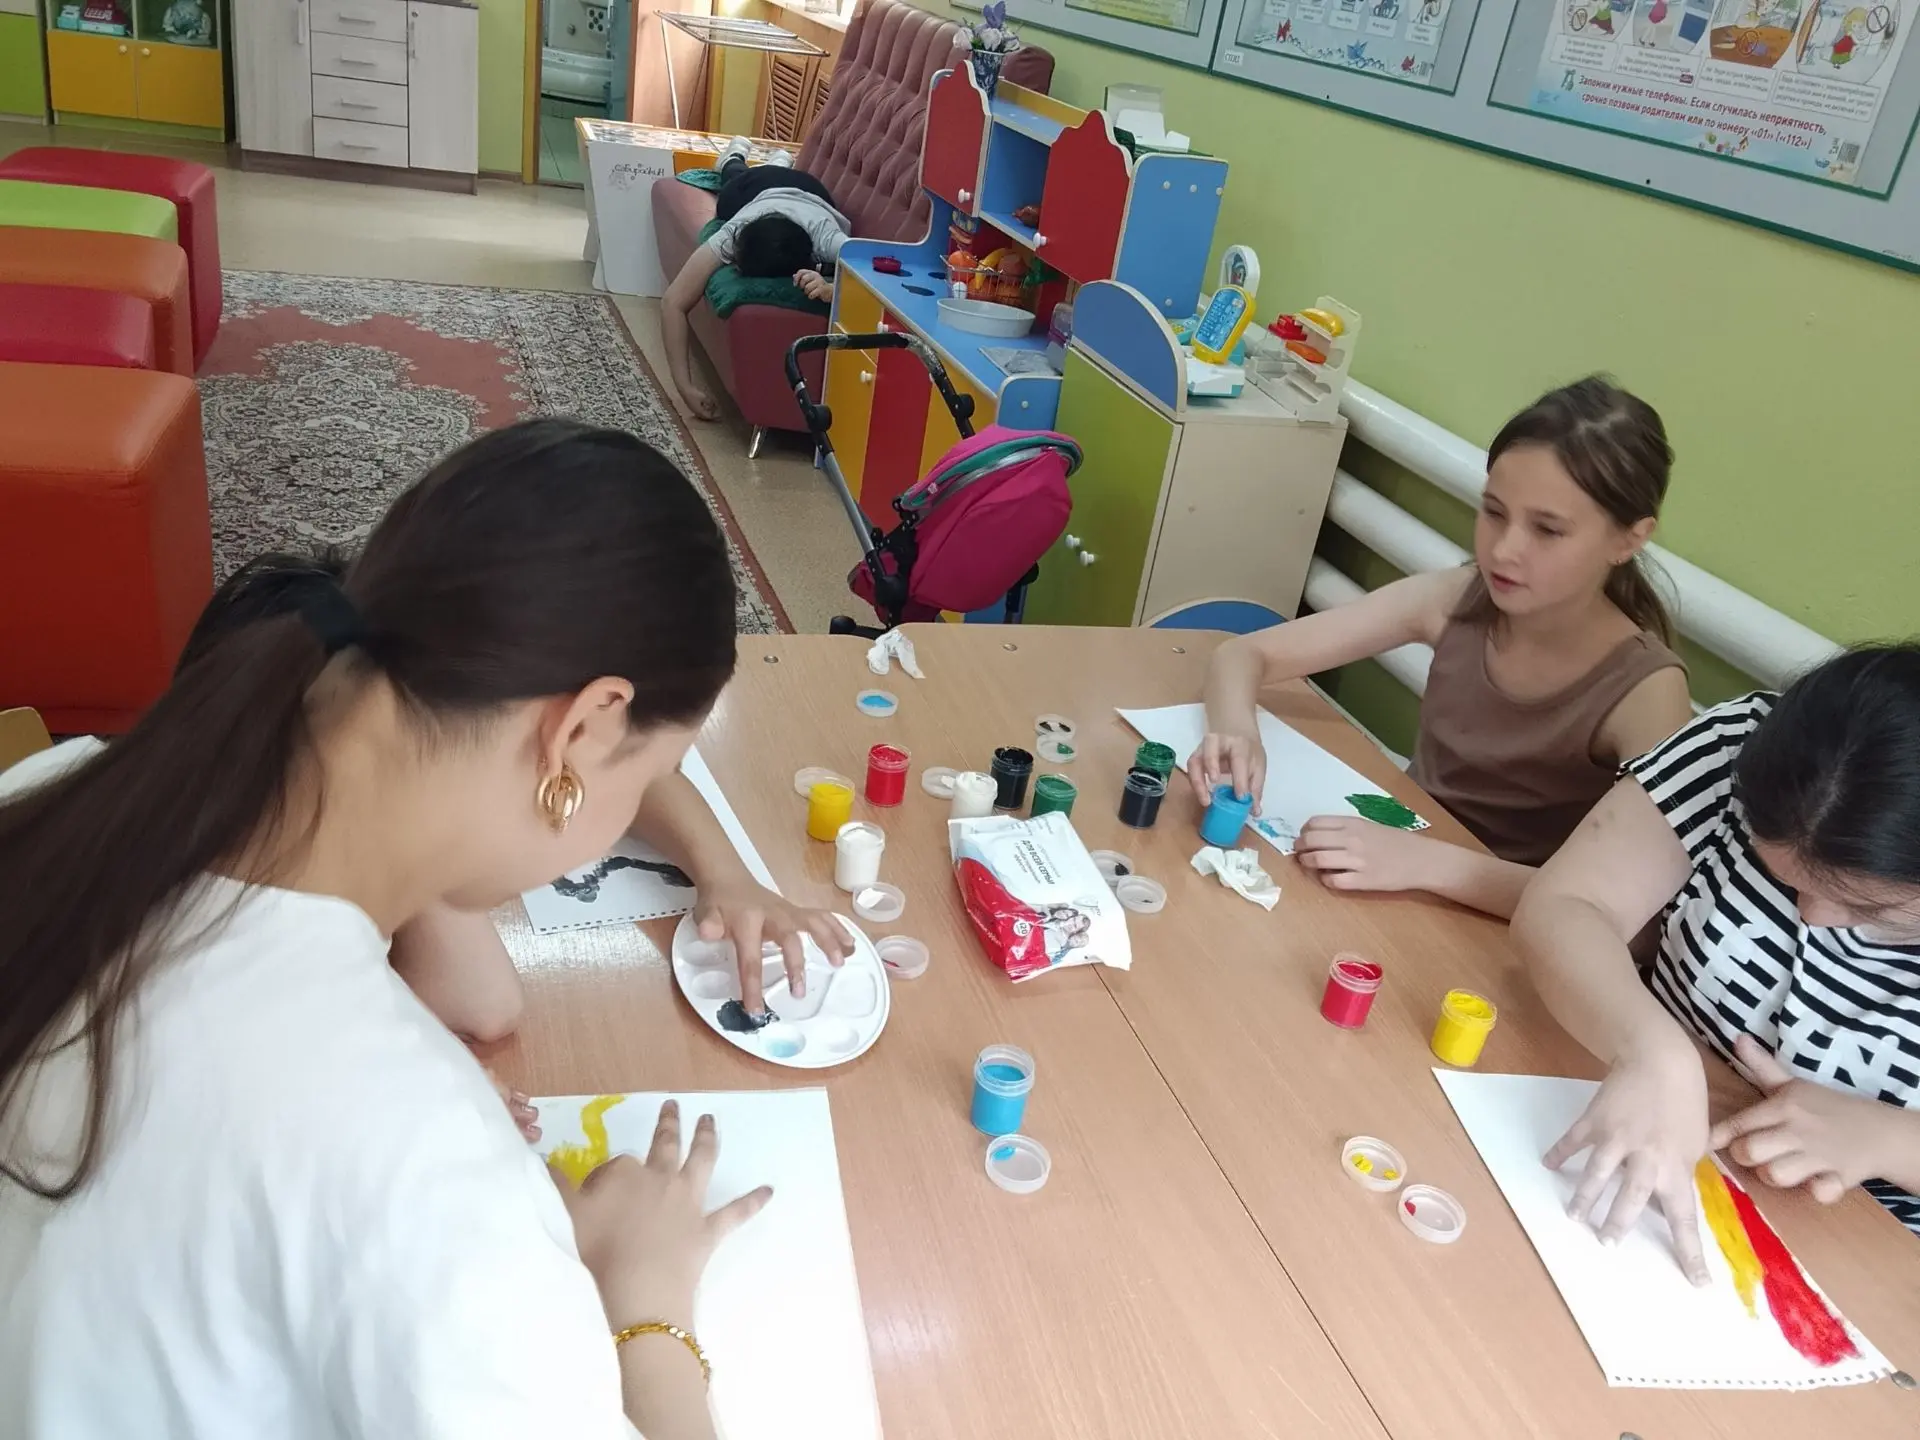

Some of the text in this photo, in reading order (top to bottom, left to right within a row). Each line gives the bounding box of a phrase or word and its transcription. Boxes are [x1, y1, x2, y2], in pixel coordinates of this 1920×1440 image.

[1579, 75, 1827, 136] Запомни нужные телефоны. Если случилась неприятность,
[1582, 93, 1607, 105] срочно
[1608, 98, 1640, 111] позвони
[1640, 105, 1686, 121] родителям
[1687, 114, 1704, 125] или
[1704, 118, 1715, 128] по
[1716, 121, 1750, 136] номеру
[1029, 851, 1044, 866] ВСЕЙ
[1038, 865, 1055, 885] СЕМЬИ
